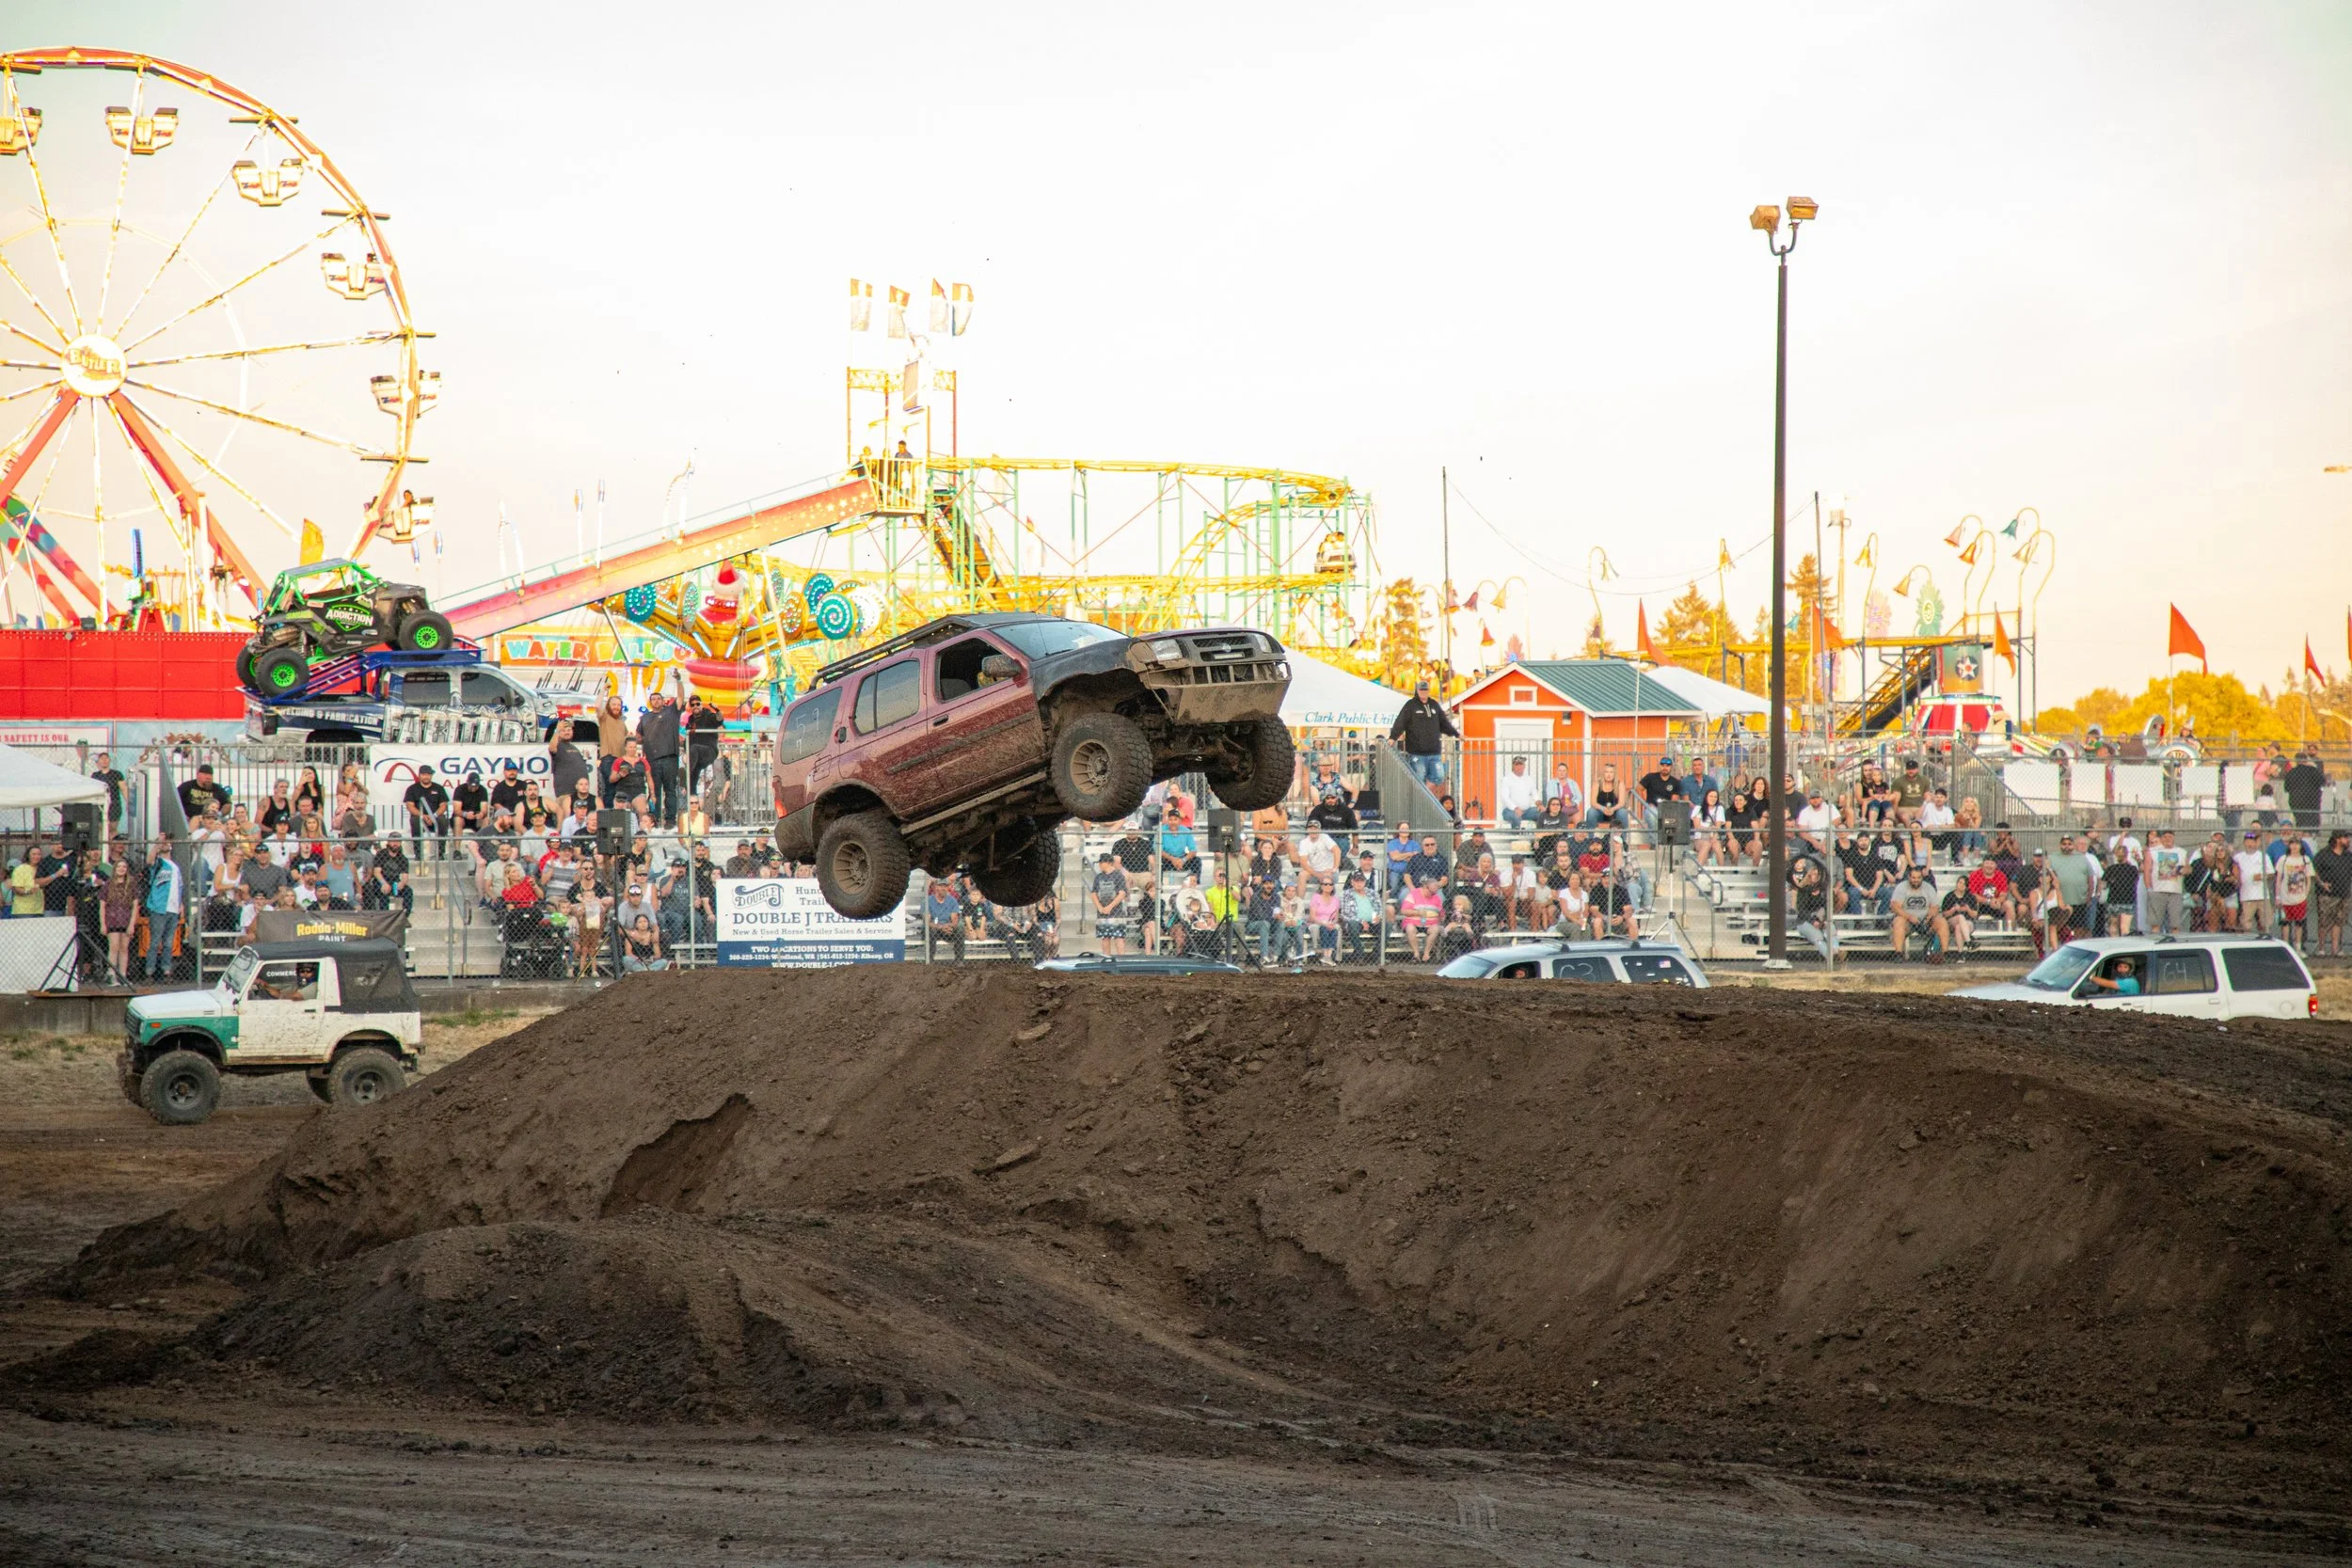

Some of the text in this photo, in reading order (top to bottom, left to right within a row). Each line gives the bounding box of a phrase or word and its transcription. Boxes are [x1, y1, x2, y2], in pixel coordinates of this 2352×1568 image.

[326, 608, 374, 627] ADDICTION
[506, 640, 691, 663] WATER BALLOO
[325, 711, 378, 726] FABRICATION
[1305, 711, 1334, 723] Clark
[1337, 712, 1372, 724] Public
[5, 734, 39, 743] SAFETY
[40, 734, 50, 742] IS
[733, 912, 801, 925] DOUBLE
[804, 911, 811, 927] J
